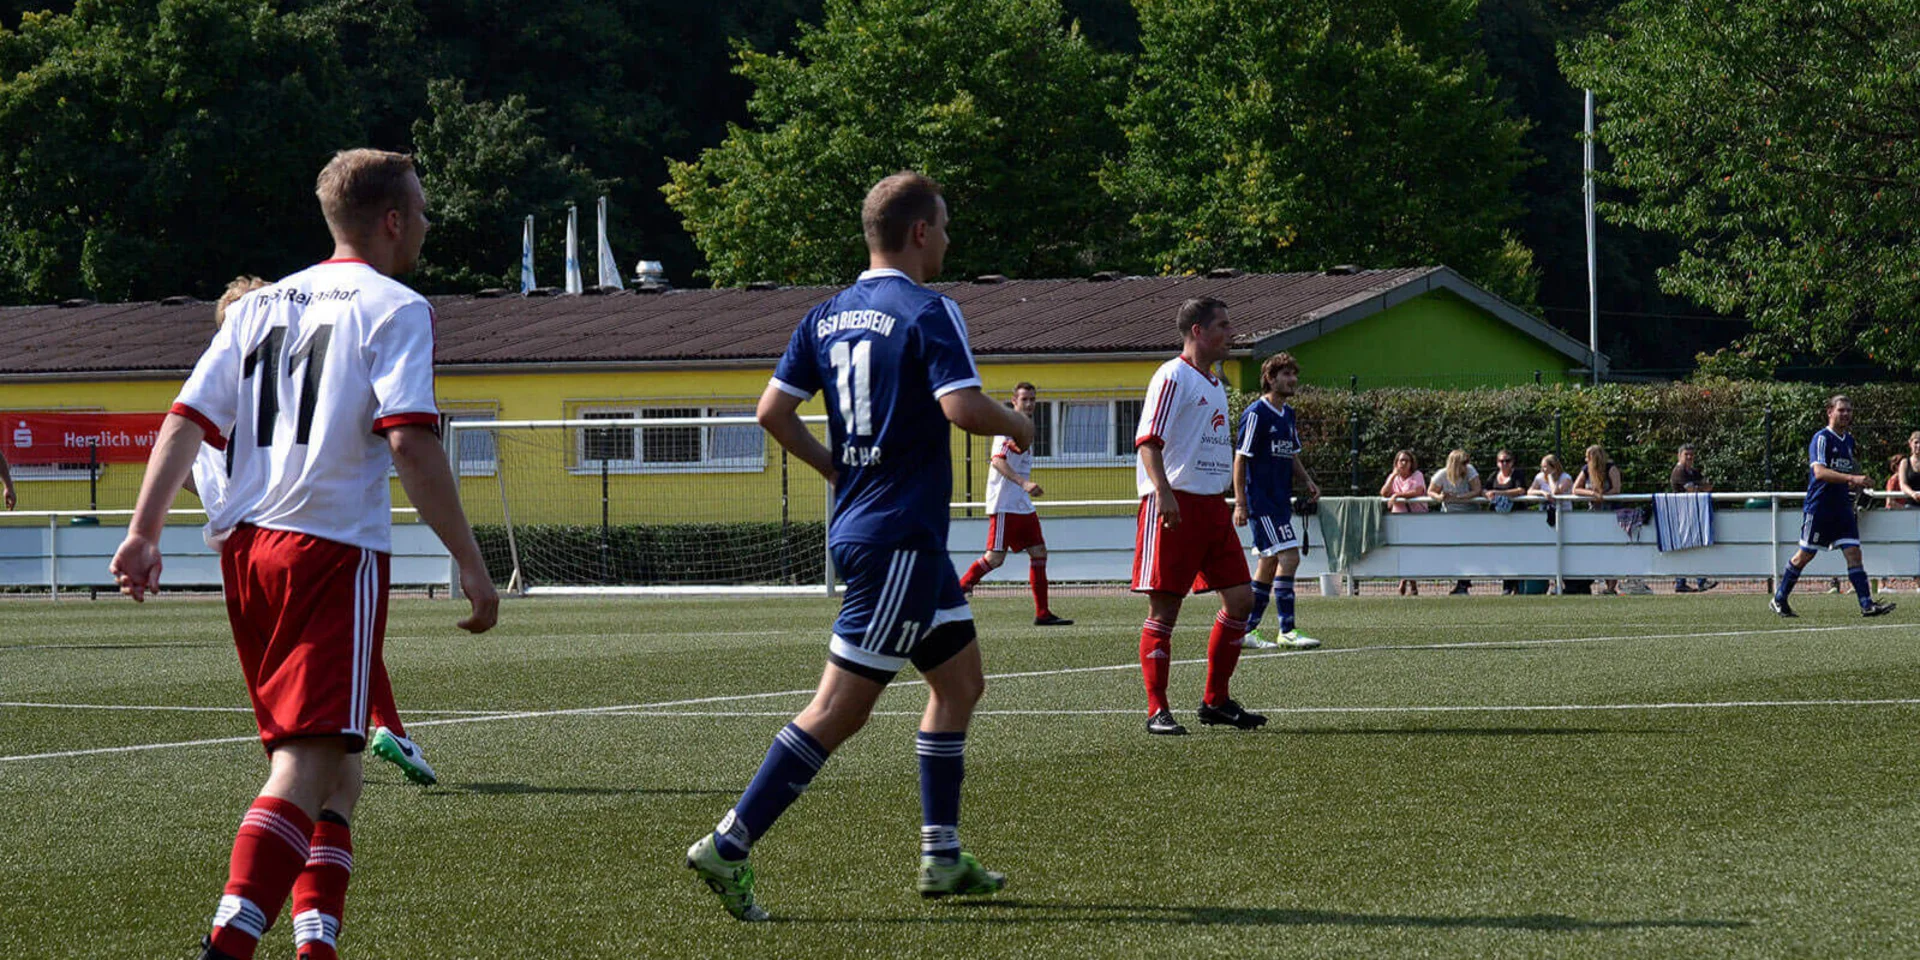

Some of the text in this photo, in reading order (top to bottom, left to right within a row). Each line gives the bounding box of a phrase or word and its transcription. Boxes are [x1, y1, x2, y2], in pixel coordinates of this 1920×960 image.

[838, 309, 896, 337] BIELSTEIN
[243, 324, 335, 448] 11
[830, 340, 872, 436] 11
[64, 431, 130, 448] Herzlich
[1278, 524, 1293, 541] 15
[894, 621, 921, 653] 11
